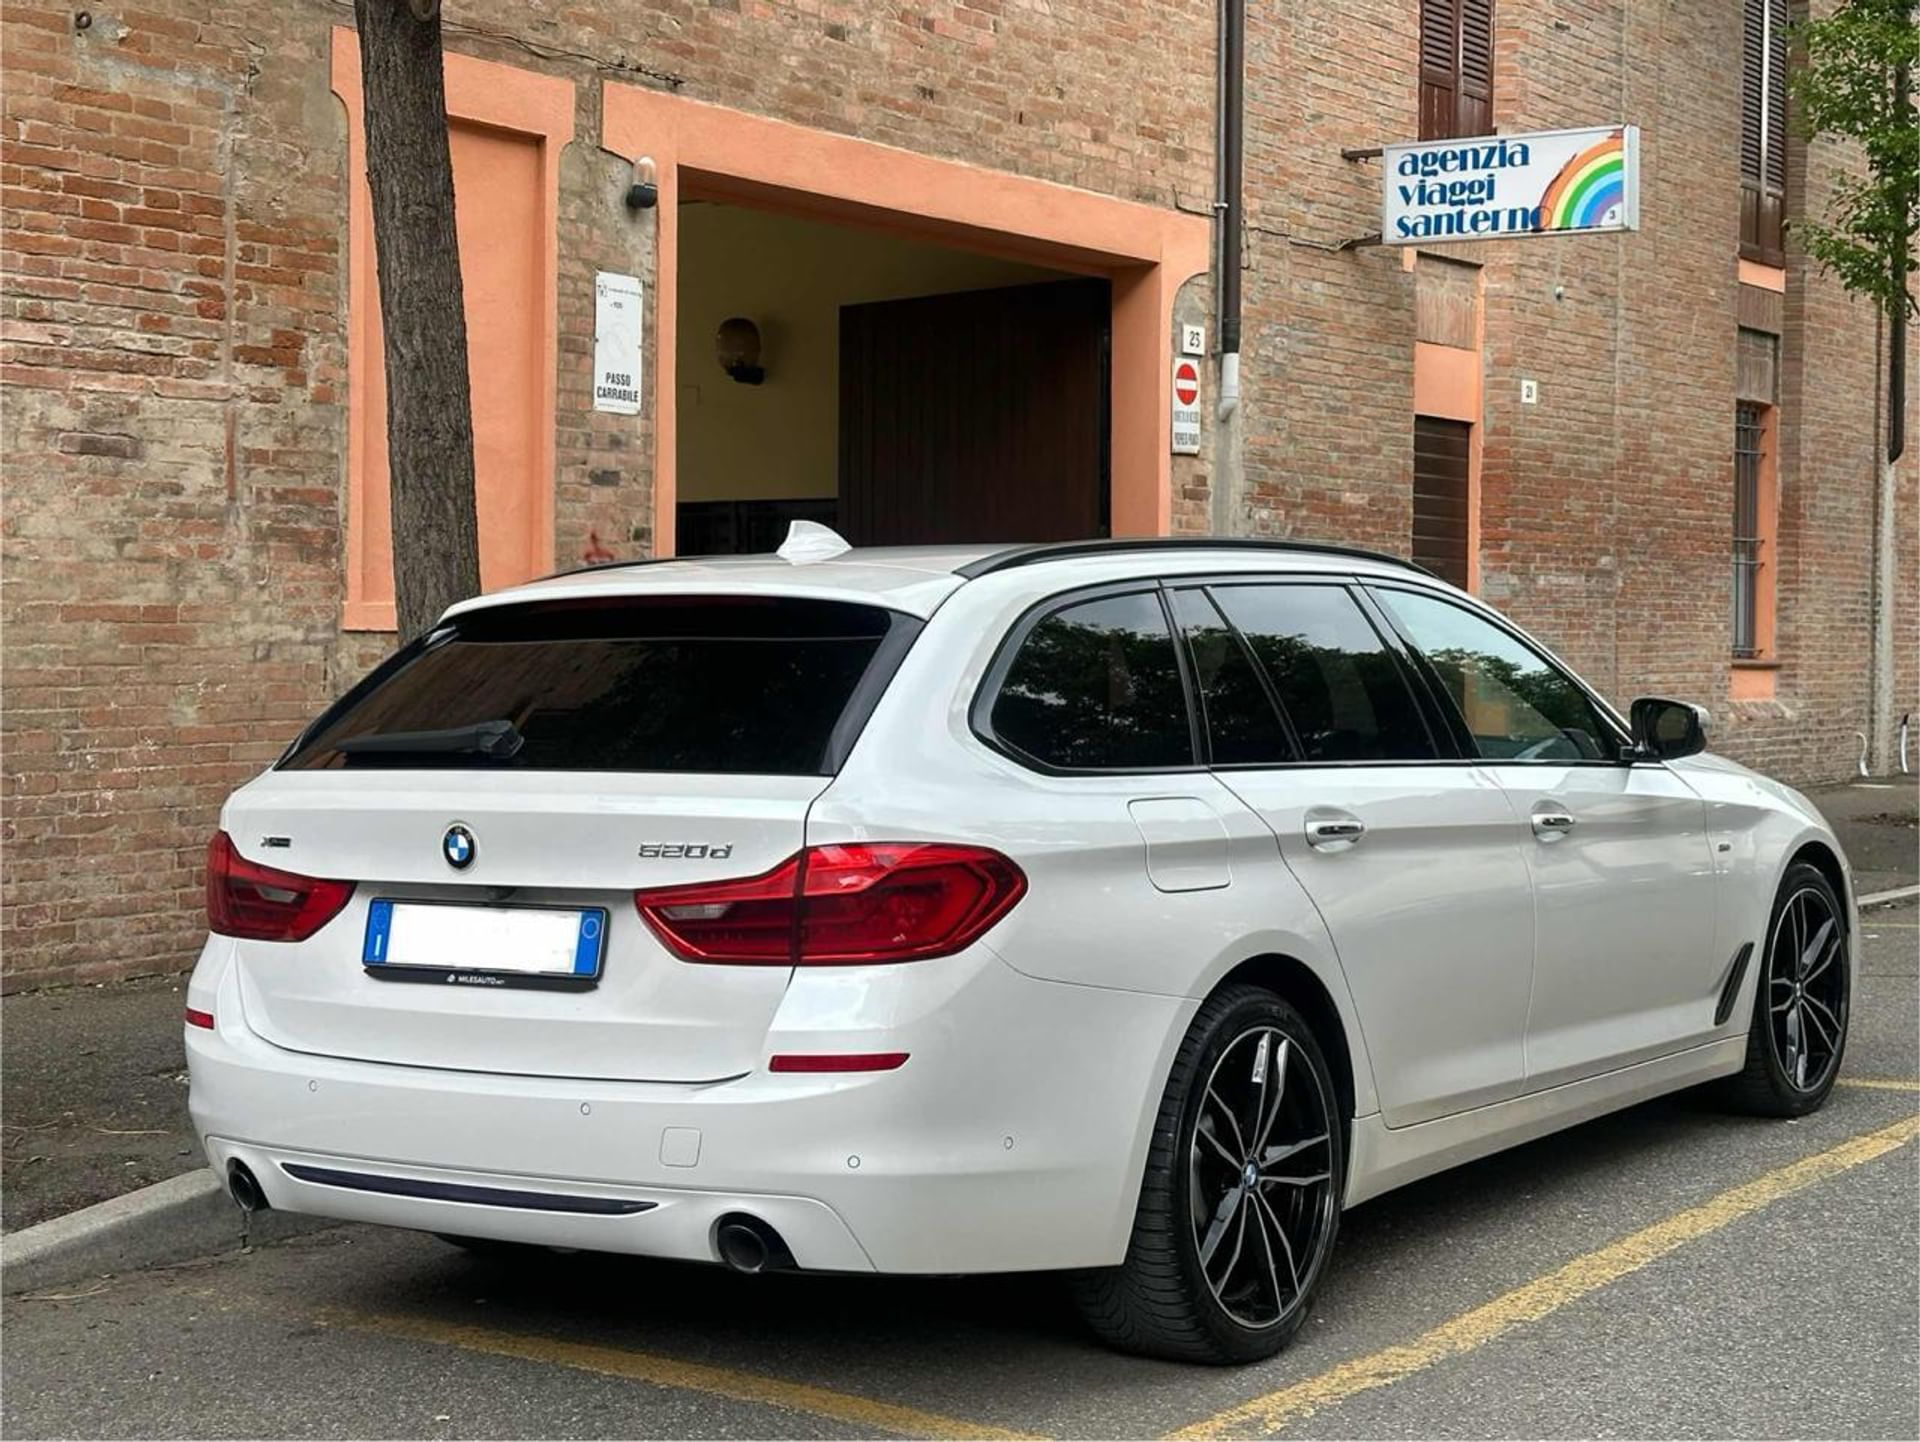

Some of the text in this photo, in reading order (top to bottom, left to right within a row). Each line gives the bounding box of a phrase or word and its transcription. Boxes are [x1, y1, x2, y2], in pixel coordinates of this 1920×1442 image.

[1398, 140, 1530, 177] agenzia
[1398, 174, 1496, 207] viaggi
[605, 371, 631, 387] PASSO
[596, 386, 639, 403] CARRABILE
[638, 842, 734, 859] 520d
